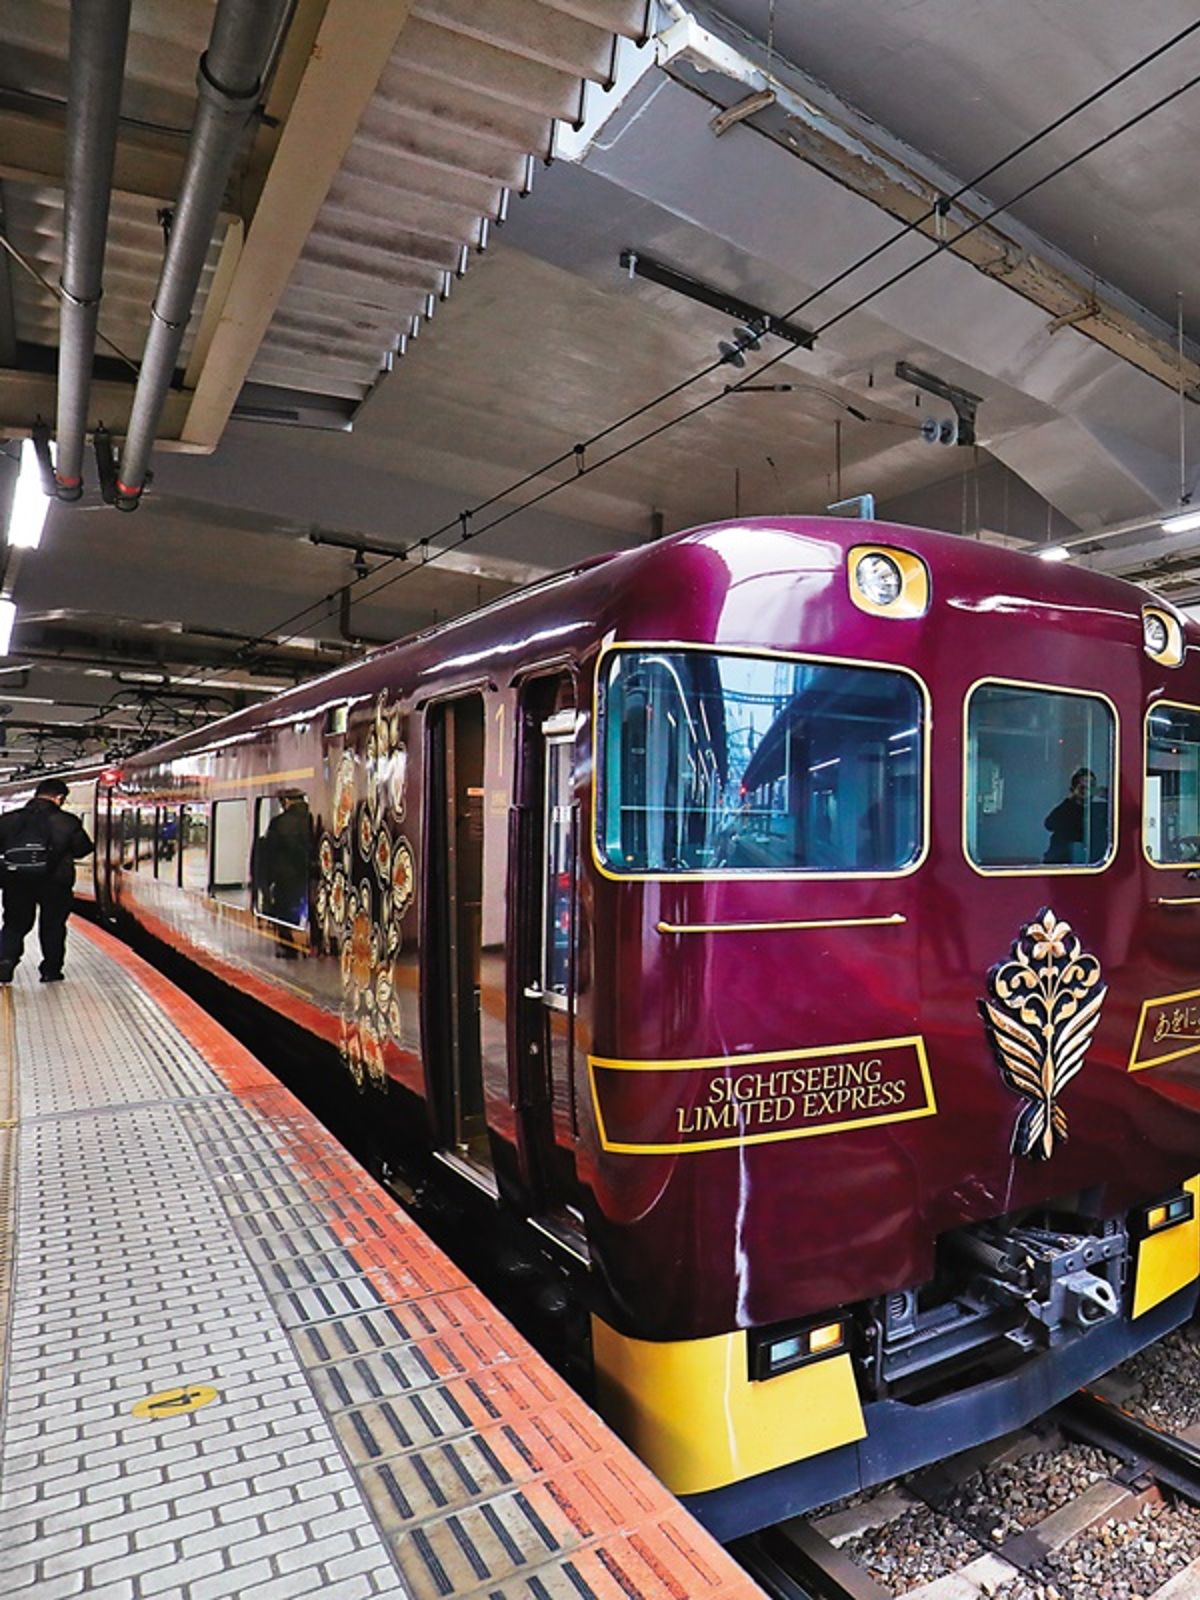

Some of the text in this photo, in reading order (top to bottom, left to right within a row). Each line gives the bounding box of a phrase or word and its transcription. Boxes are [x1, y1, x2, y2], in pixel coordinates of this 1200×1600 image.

[675, 1079, 906, 1133] LIMITED EXPRESS
[708, 1059, 882, 1104] SIGHTSEEING
